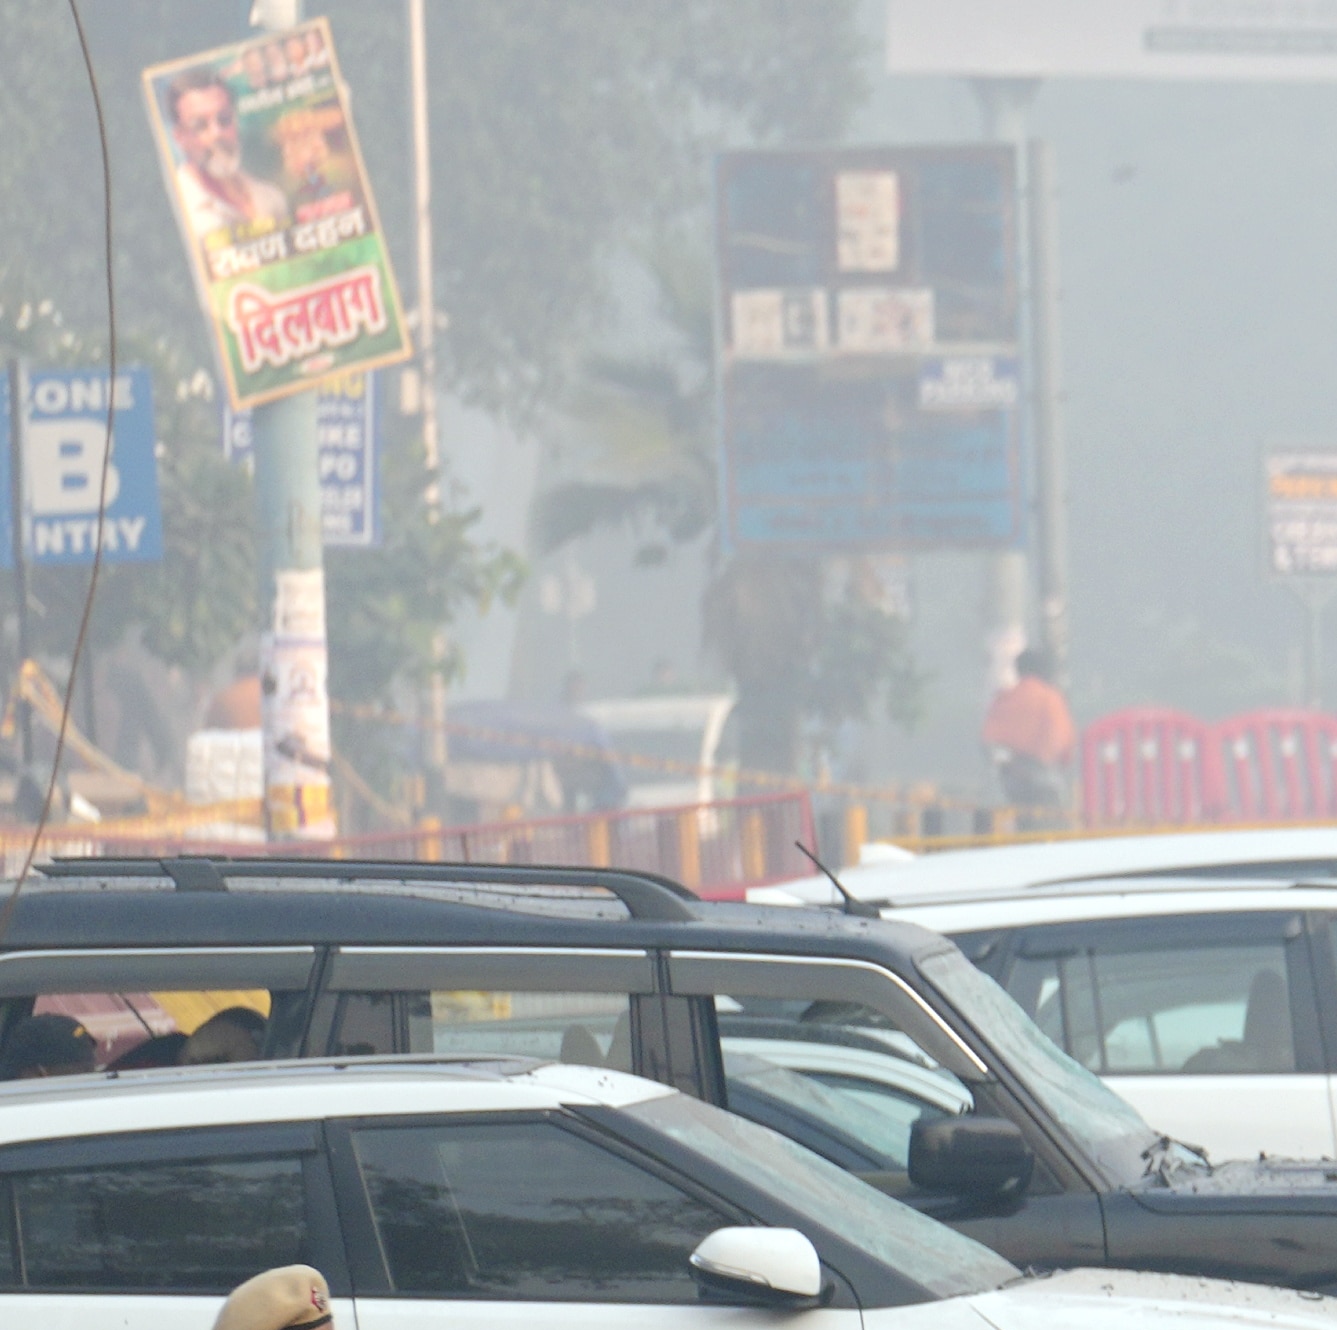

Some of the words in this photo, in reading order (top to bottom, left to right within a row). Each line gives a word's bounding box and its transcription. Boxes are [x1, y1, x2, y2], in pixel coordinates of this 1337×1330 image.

[230, 267, 383, 368] दिलबाग
[22, 376, 135, 415] ONE
[28, 418, 120, 515] B
[22, 517, 147, 556] NTRY
